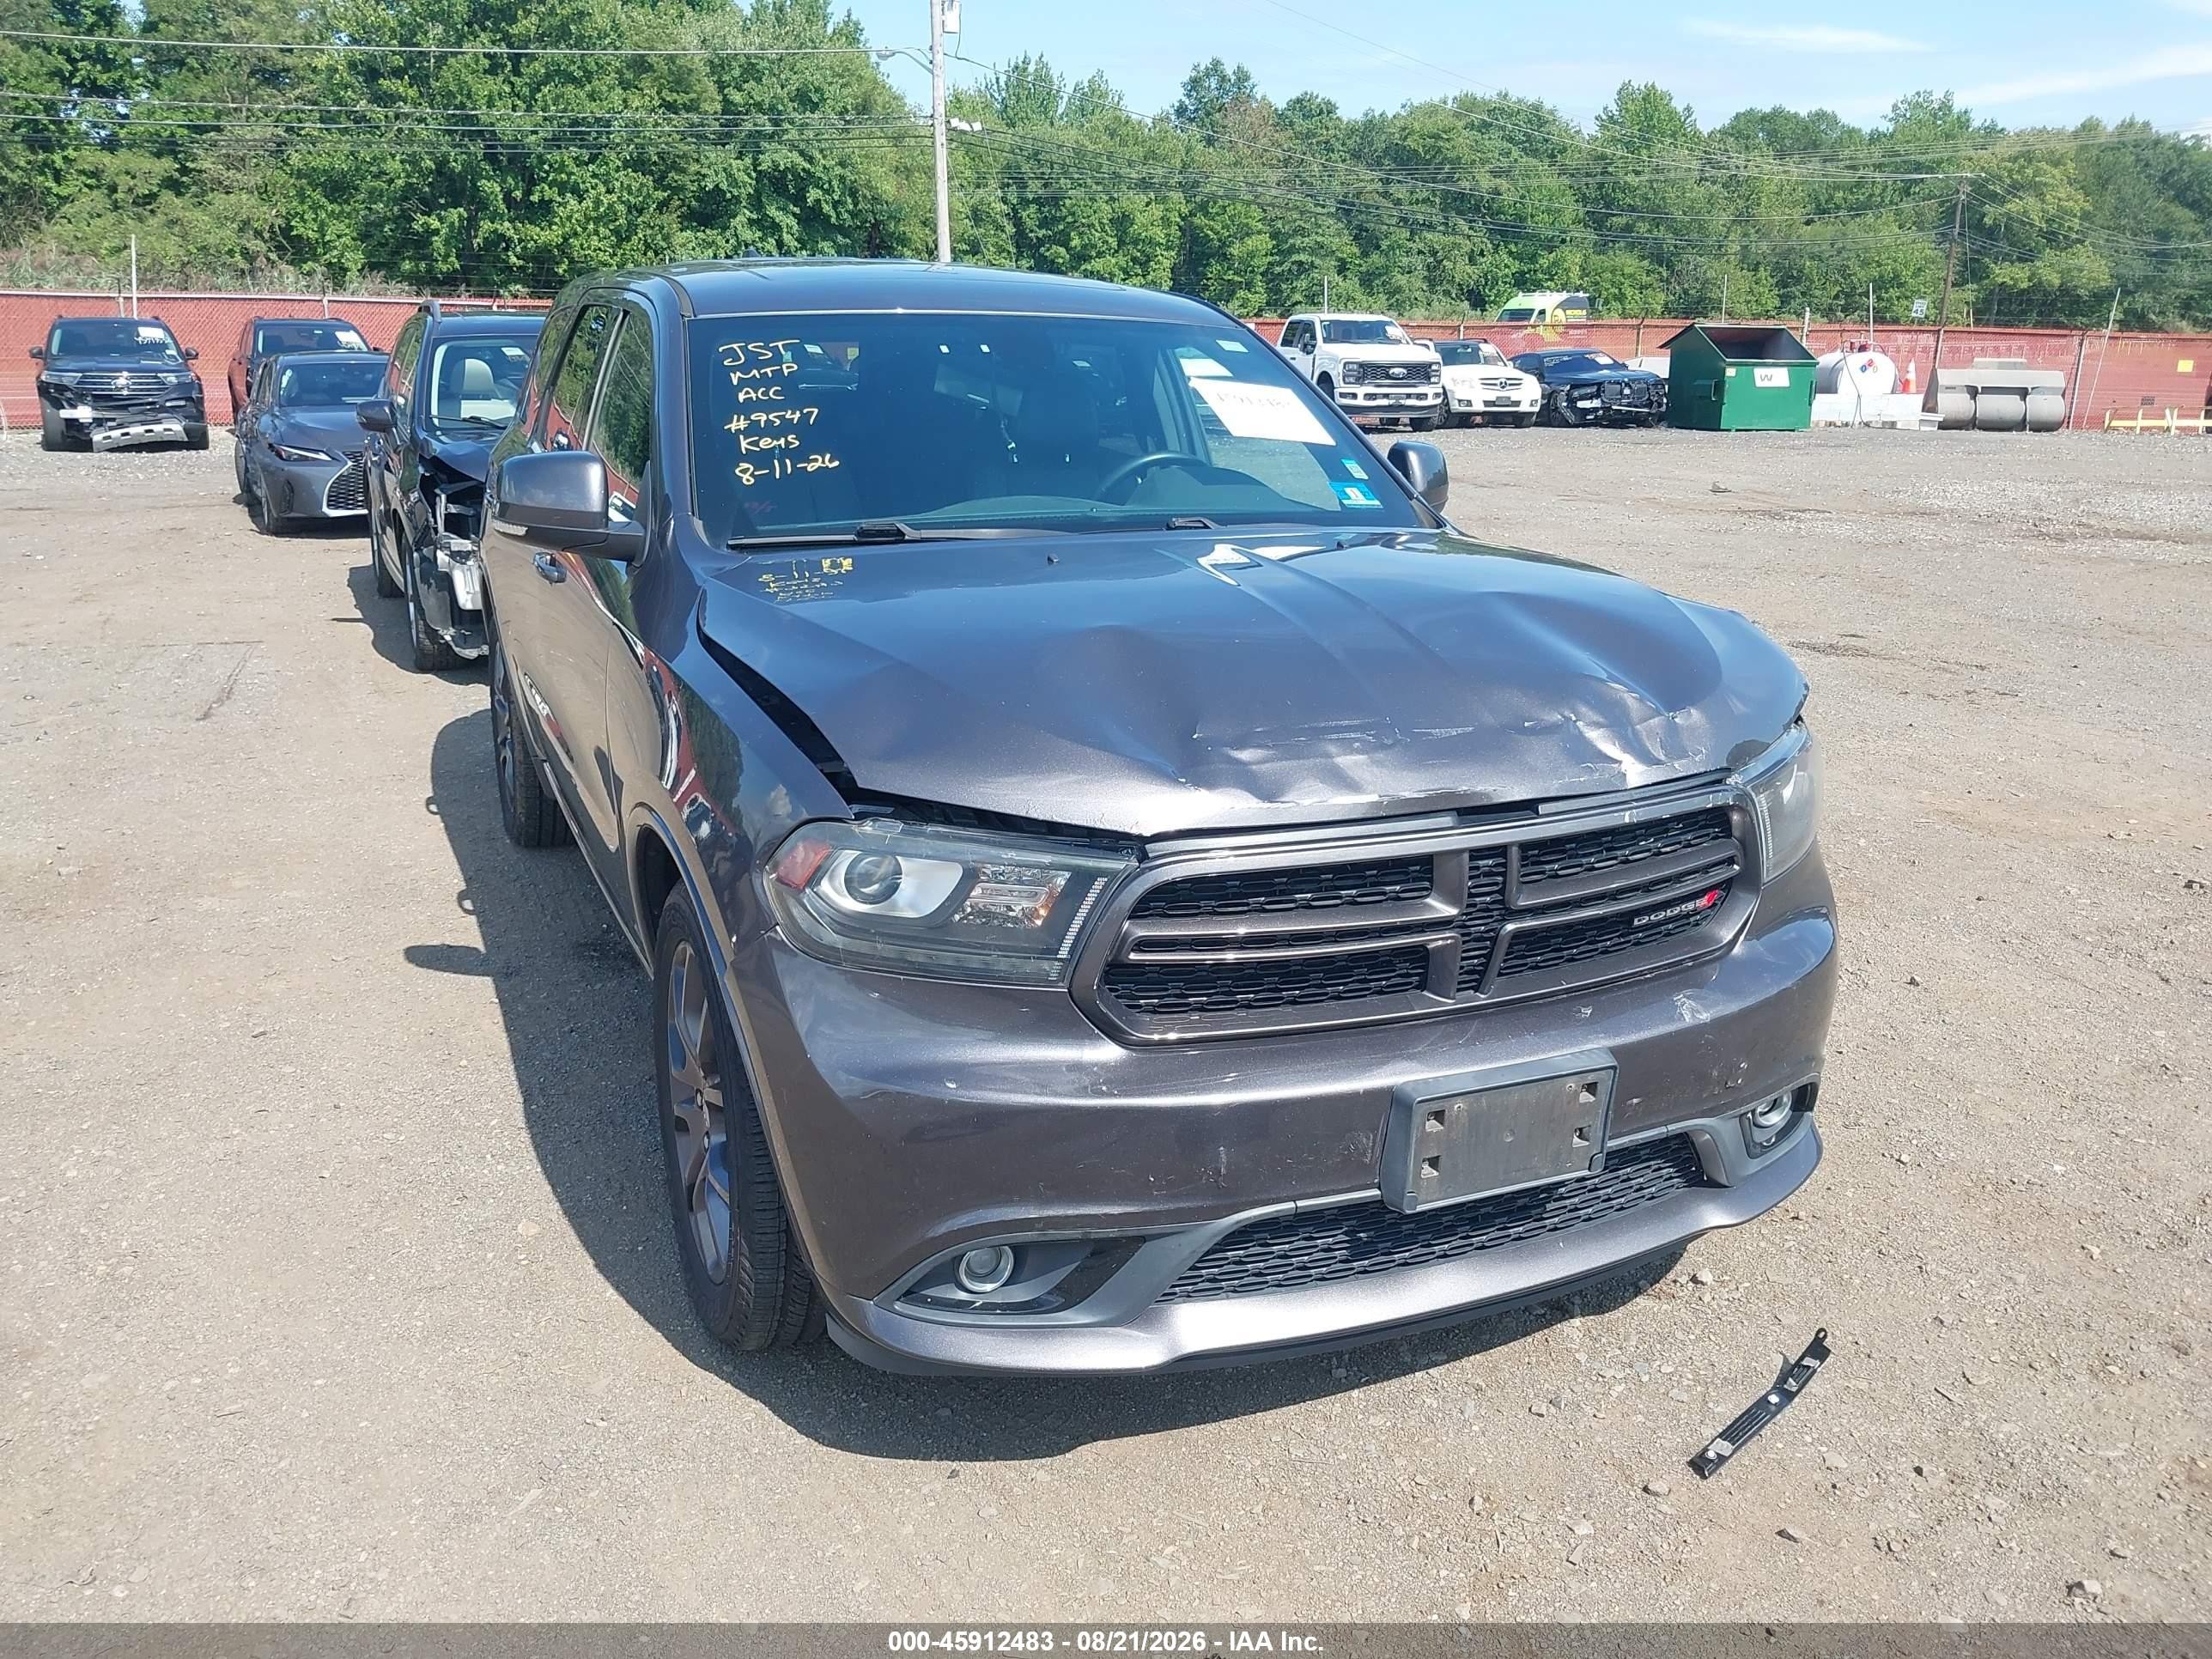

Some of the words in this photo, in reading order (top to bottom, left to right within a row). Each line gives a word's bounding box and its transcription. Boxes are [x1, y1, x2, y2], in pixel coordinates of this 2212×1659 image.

[1760, 374, 1773, 382] W
[738, 386, 785, 404] ACC
[723, 408, 818, 433] #9547
[738, 434, 800, 454] Keys
[734, 453, 840, 485] 8-11-26
[1633, 898, 1705, 927] DODGE
